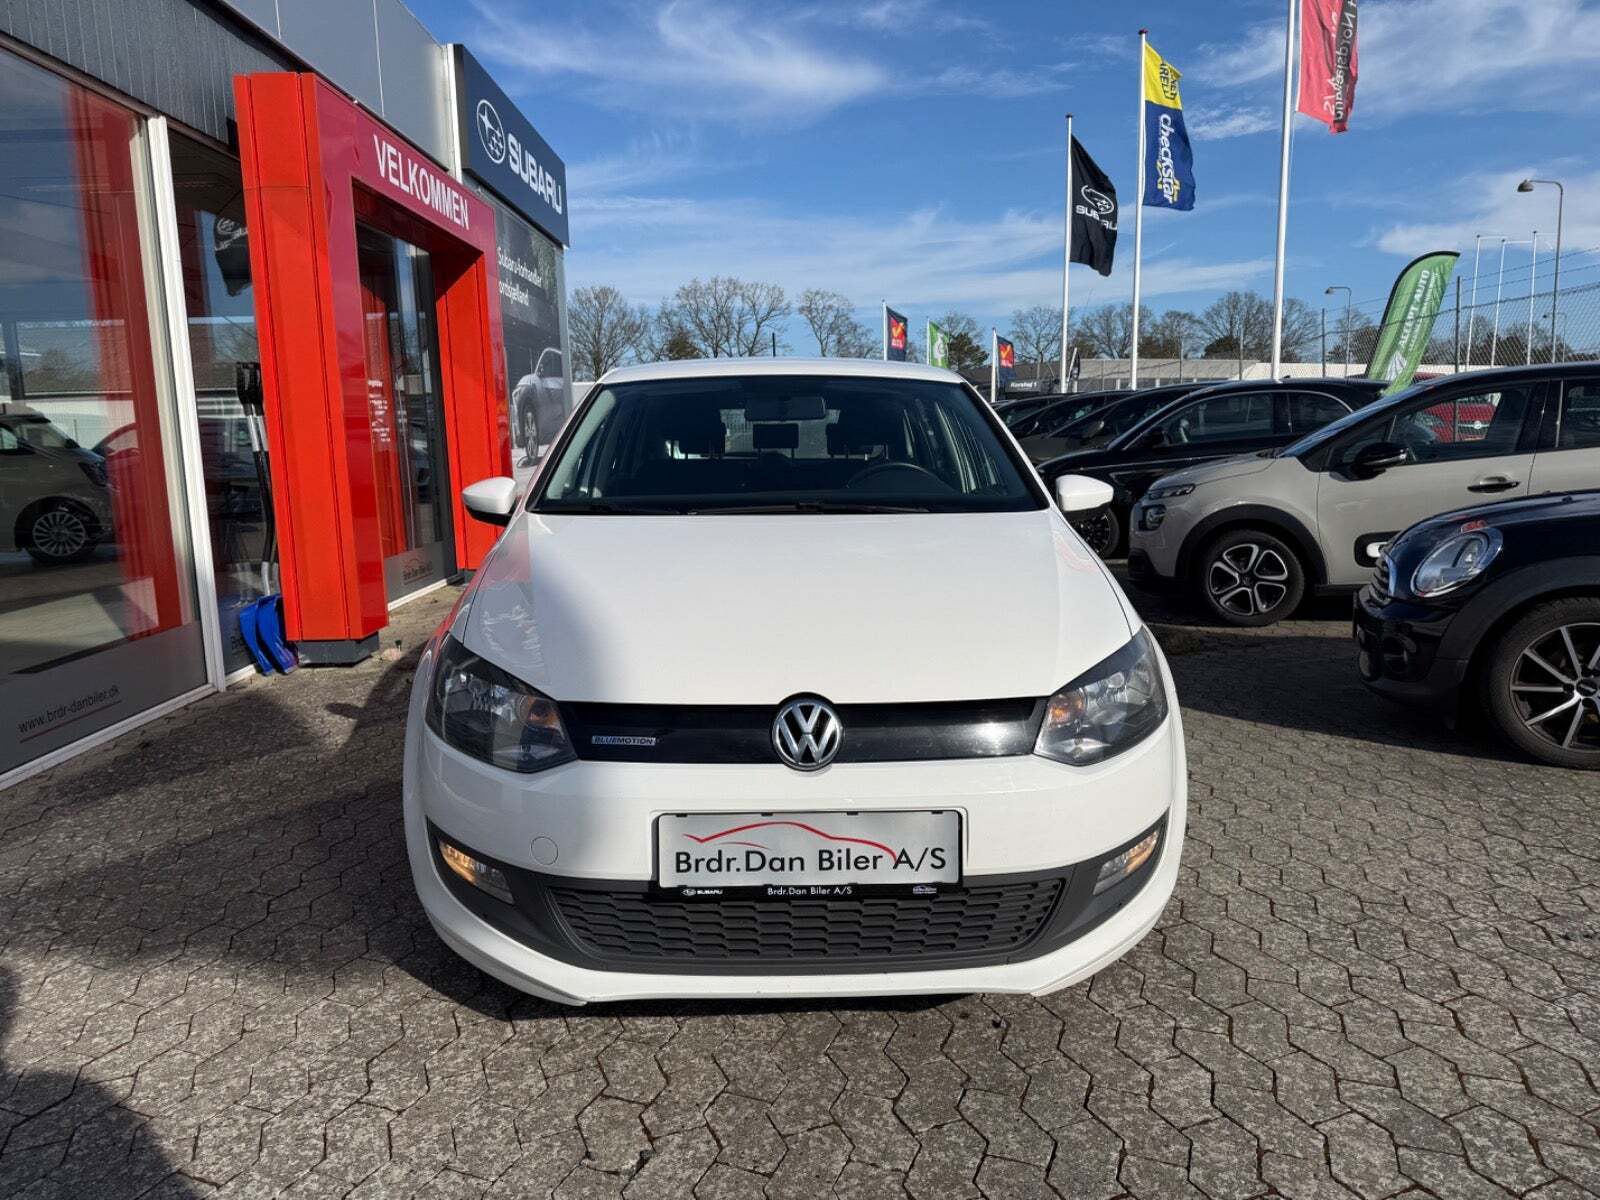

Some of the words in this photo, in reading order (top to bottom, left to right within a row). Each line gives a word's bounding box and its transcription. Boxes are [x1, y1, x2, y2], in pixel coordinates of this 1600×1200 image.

[373, 133, 470, 231] VELKOMMEN
[507, 132, 563, 216] SUBARU
[1075, 204, 1118, 230] SUBRU
[499, 278, 529, 306] ordsjælland
[592, 735, 656, 746] BLUEMOTION
[675, 849, 805, 874] Brdr.Dan
[818, 847, 883, 871] Biler
[892, 847, 947, 872] A/S
[767, 887, 807, 896] Brdr.Dan
[810, 887, 831, 896] Biler
[834, 886, 853, 896] A/S
